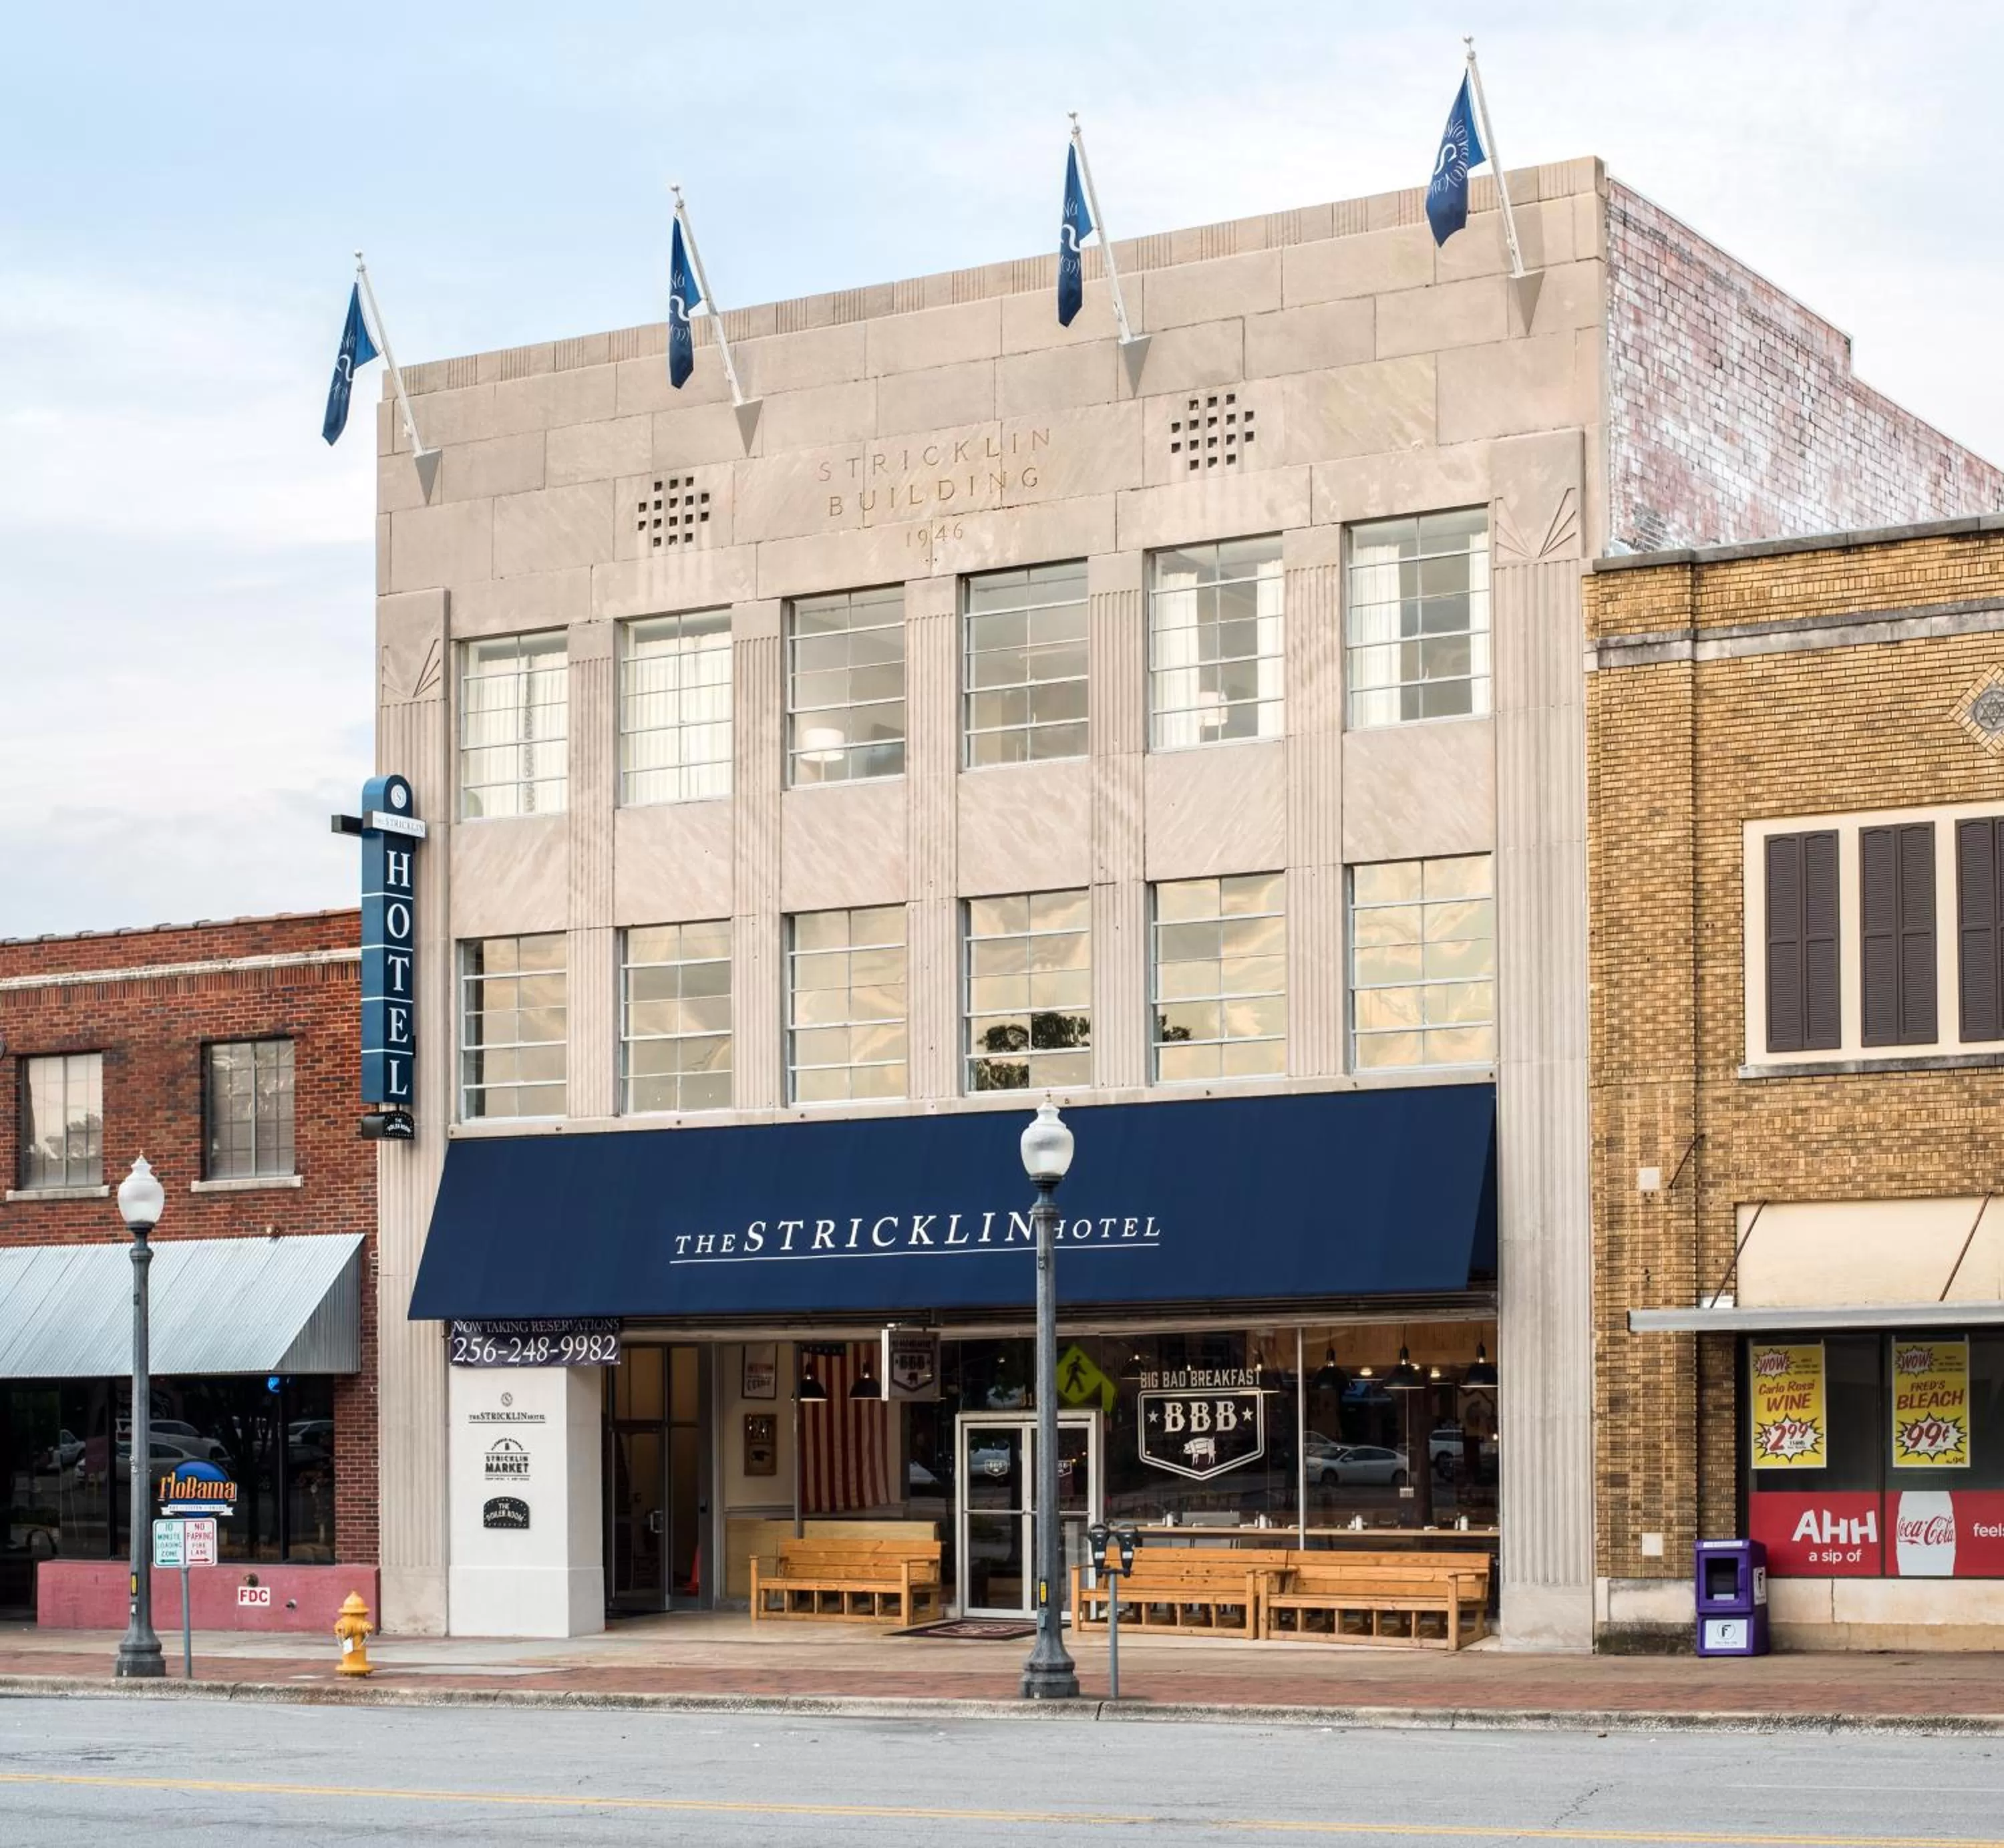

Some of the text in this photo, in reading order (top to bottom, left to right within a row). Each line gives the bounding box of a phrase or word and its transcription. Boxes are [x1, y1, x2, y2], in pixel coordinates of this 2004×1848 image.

[816, 428, 1050, 482] STRICKLIN
[829, 468, 1038, 517] BUILDING
[906, 522, 964, 549] 1946
[387, 849, 411, 1096] HOTEL
[675, 1233, 735, 1255] THE
[743, 1210, 1033, 1252] STRICKLIN
[453, 1319, 619, 1333] NOW TAKING RESERVATIONS
[452, 1335, 617, 1363] 256-248-9982
[1140, 1368, 1261, 1388] BIG BAD BREAKFAST
[1759, 1379, 1815, 1395] Carlo Rossi
[1910, 1380, 1945, 1392] FRED'S
[1766, 1392, 1812, 1412] WINE
[1897, 1388, 1965, 1410] BLEACH
[480, 1412, 527, 1420] STRICKLIN
[1164, 1400, 1237, 1432] BBB
[485, 1462, 528, 1473] MARKET
[1808, 1549, 1862, 1564] a sip of
[239, 1589, 269, 1603] FDC
[1721, 1624, 1731, 1638] F
